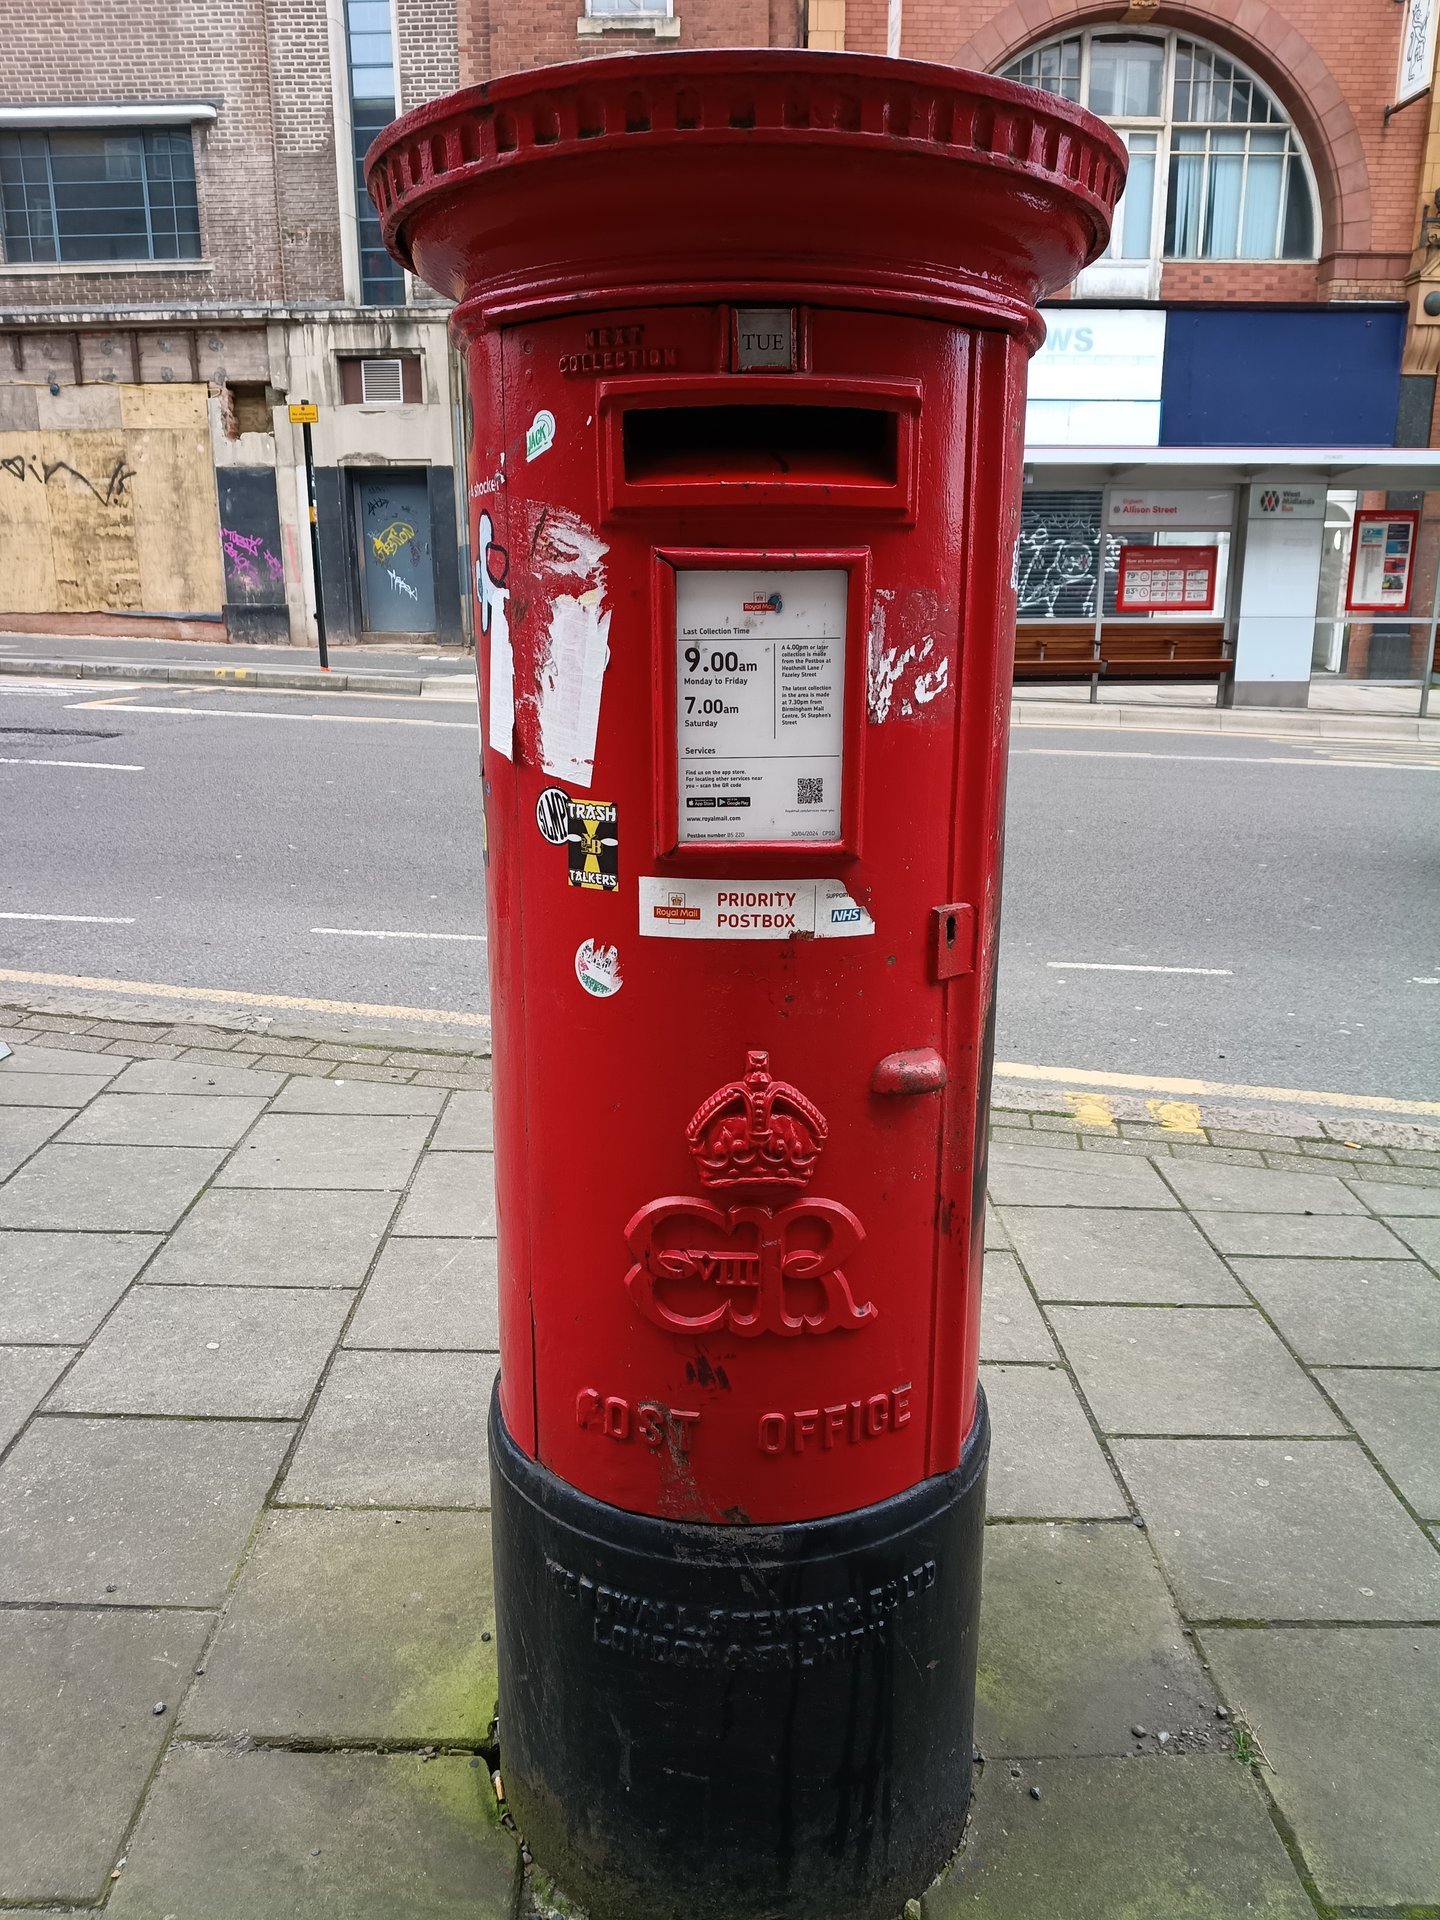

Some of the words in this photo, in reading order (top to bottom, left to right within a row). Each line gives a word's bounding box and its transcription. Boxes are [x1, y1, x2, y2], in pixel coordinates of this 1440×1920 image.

[584, 326, 643, 348] NEXT
[742, 333, 785, 350] TUE
[559, 350, 678, 373] COLLECTION
[1123, 506, 1150, 514] Allison
[1152, 506, 1177, 514] Street
[744, 603, 761, 611] Royal
[786, 644, 808, 652] 4.00pm
[684, 647, 757, 672] 9.00am
[684, 678, 713, 686] Monday
[725, 677, 748, 685] Friday
[684, 696, 739, 714] 7.00am
[568, 803, 617, 821] TRASH
[569, 870, 617, 886] TALKERS
[717, 893, 796, 907] PRIORITY
[656, 908, 679, 917] Royal
[680, 908, 698, 917] Mail
[832, 908, 860, 922] NHS
[717, 914, 796, 928] POSTBOX
[576, 1387, 701, 1447] POST
[758, 1381, 913, 1455] OFFICE
